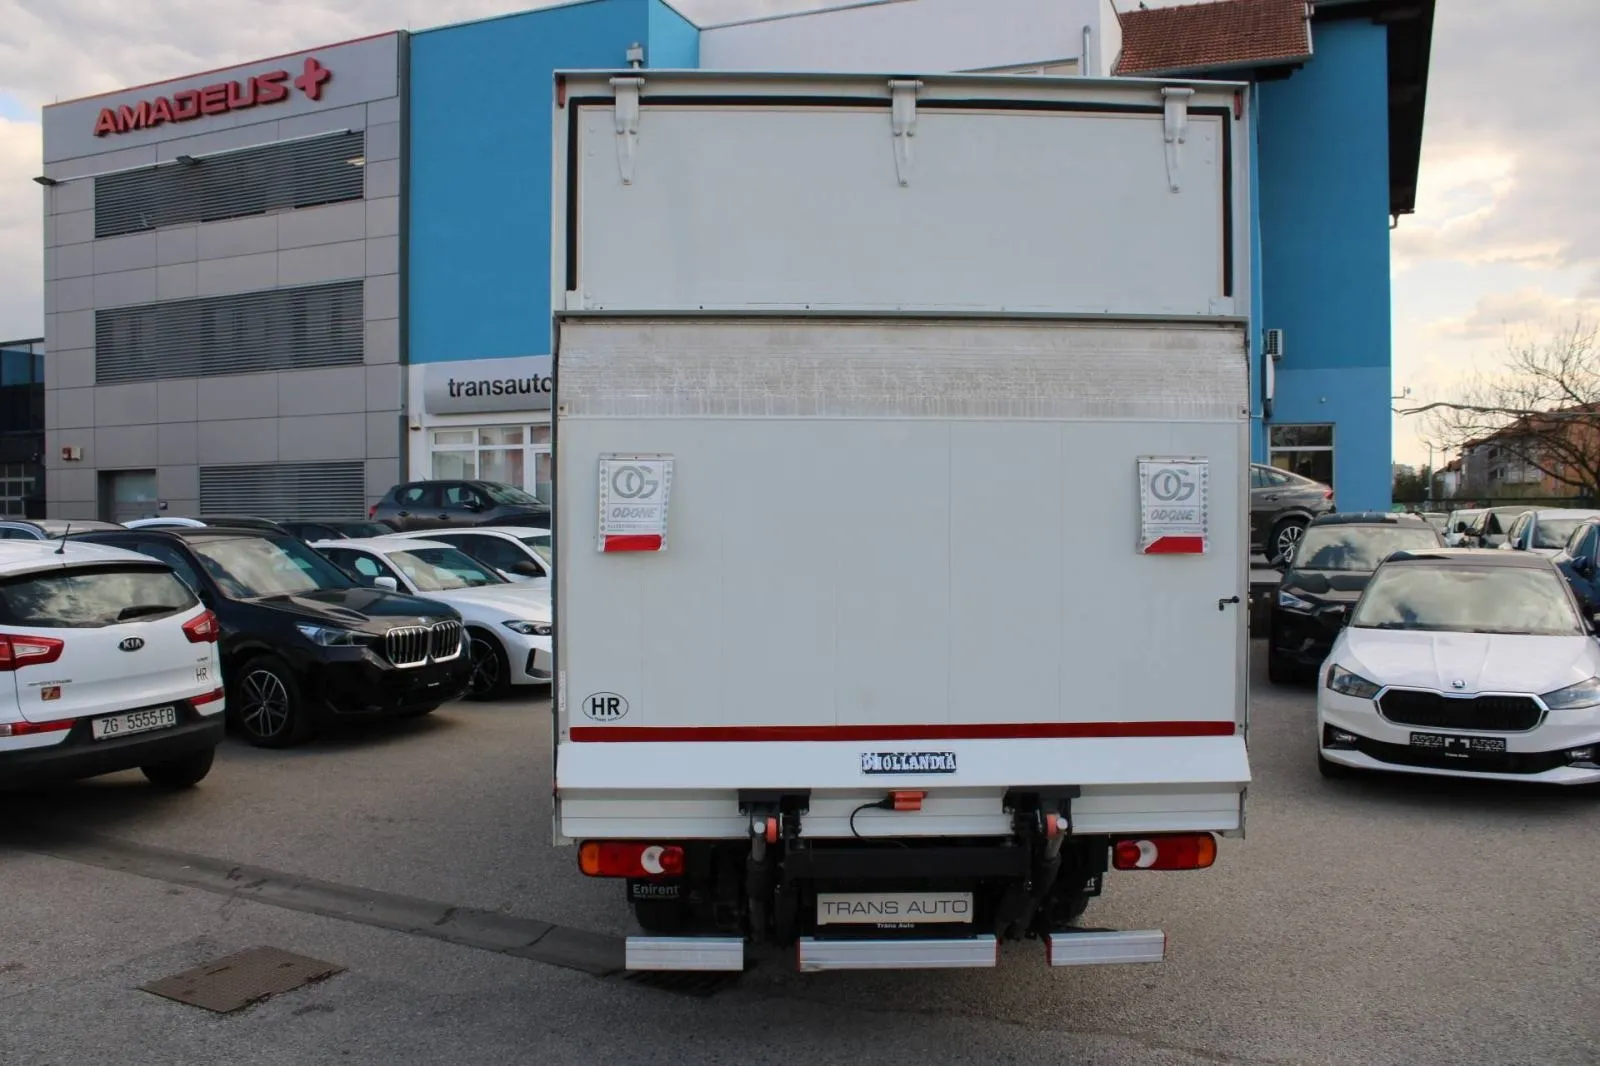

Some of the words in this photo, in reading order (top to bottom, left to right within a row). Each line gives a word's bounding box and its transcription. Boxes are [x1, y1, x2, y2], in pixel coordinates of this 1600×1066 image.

[93, 70, 289, 137] AMADEUS
[123, 638, 142, 649] KIA
[195, 667, 209, 682] HR
[592, 697, 620, 716] HR
[102, 718, 119, 735] ZG
[632, 884, 680, 894] Enirent
[823, 901, 899, 915] TRANS
[906, 900, 968, 914] AUTO
